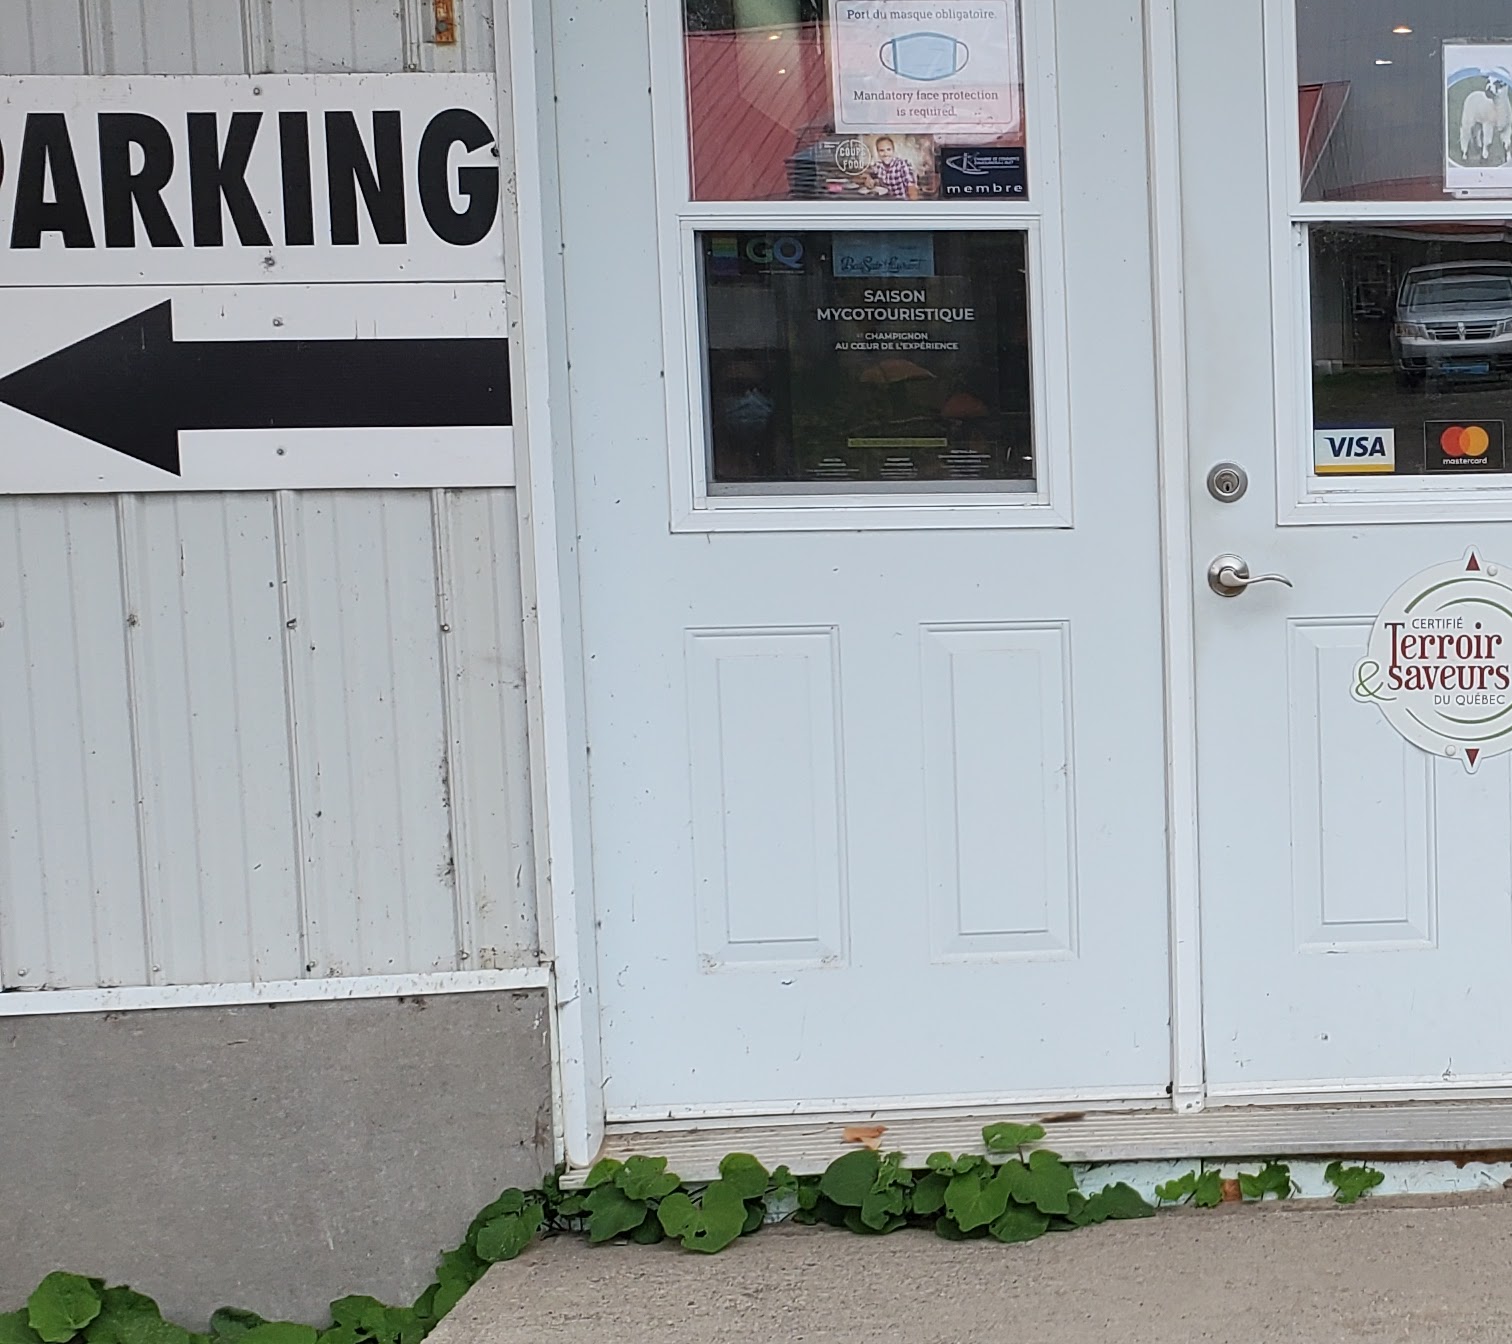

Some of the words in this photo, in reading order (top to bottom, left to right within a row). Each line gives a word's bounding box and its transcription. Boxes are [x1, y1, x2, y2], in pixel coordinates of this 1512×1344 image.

[847, 9, 871, 20] Port
[873, 9, 887, 20] du
[890, 10, 933, 22] masque
[936, 8, 998, 22] obligatoire.
[853, 90, 914, 104] Mandatory
[916, 90, 940, 101] face
[942, 90, 999, 104] protection
[896, 107, 907, 117] is
[0, 108, 499, 249] ARKING
[946, 182, 1024, 194] membre
[864, 289, 926, 303] SAISON
[816, 308, 975, 323] MYCOTOURISTIQUE
[865, 332, 929, 340] CHAMPIGNON
[834, 342, 849, 350] AU
[881, 342, 895, 350] DE
[896, 340, 960, 351] L'EXPÉRIENCE
[1324, 436, 1386, 458] VISA
[1442, 456, 1488, 466] mastercard
[1412, 616, 1464, 629] CERTIFIÉ
[1384, 621, 1503, 667] Terroir
[1355, 660, 1397, 701] &
[1434, 694, 1451, 705] DU
[1455, 692, 1506, 706] QUÉBEC
